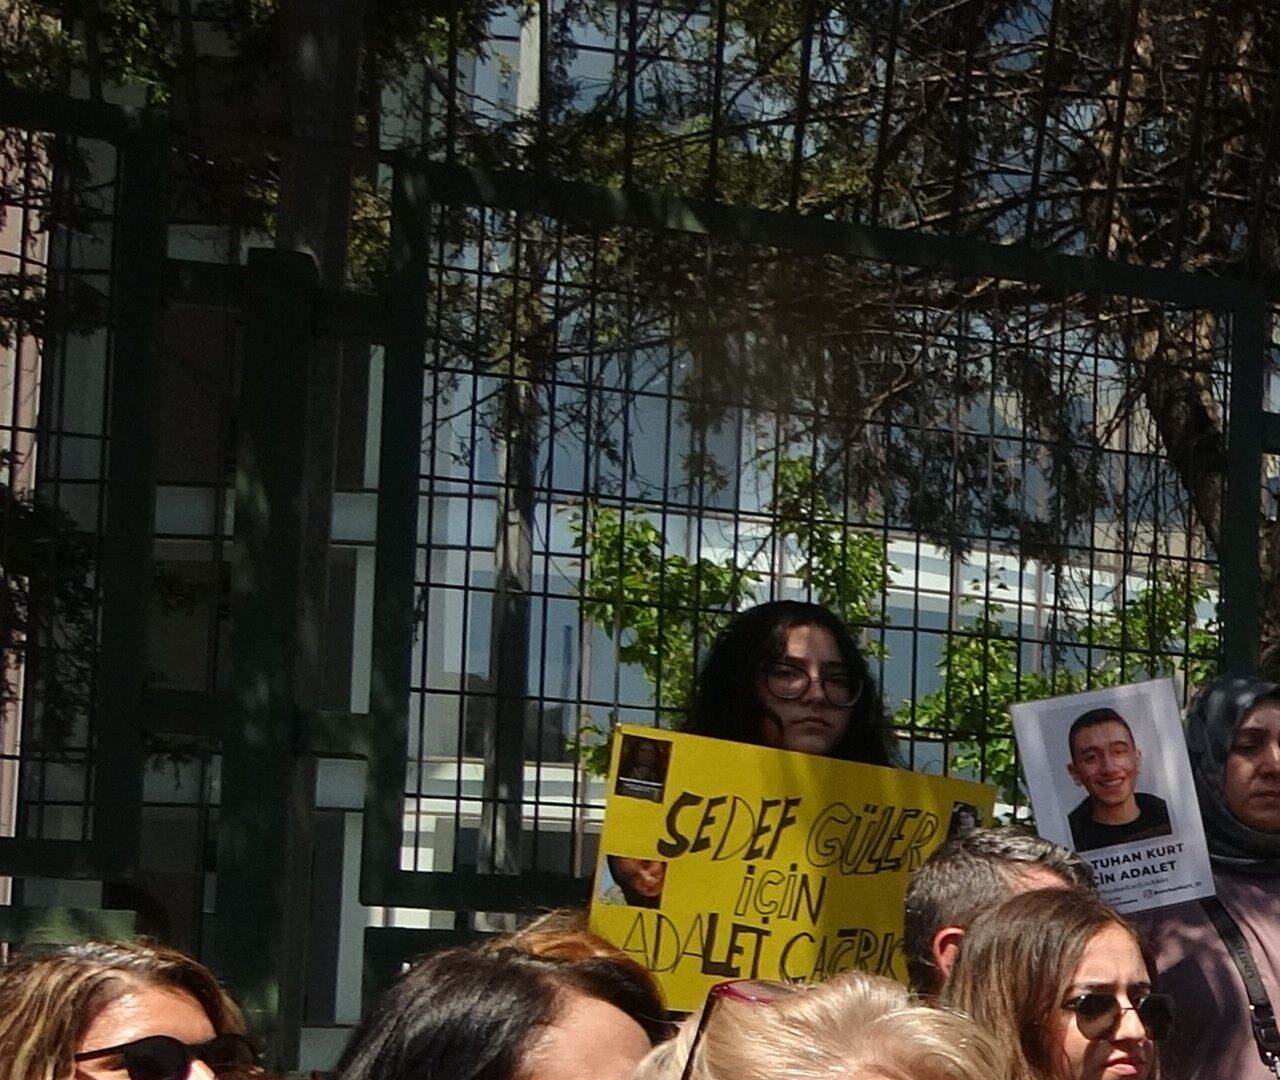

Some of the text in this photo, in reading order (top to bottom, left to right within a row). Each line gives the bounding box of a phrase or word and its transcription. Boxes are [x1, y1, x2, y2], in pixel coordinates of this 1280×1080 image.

[657, 792, 939, 875] SEDEF GÜLER
[1090, 843, 1184, 869] TUHAN KURT
[1120, 861, 1176, 880] ADALET
[623, 911, 772, 980] ADALET
